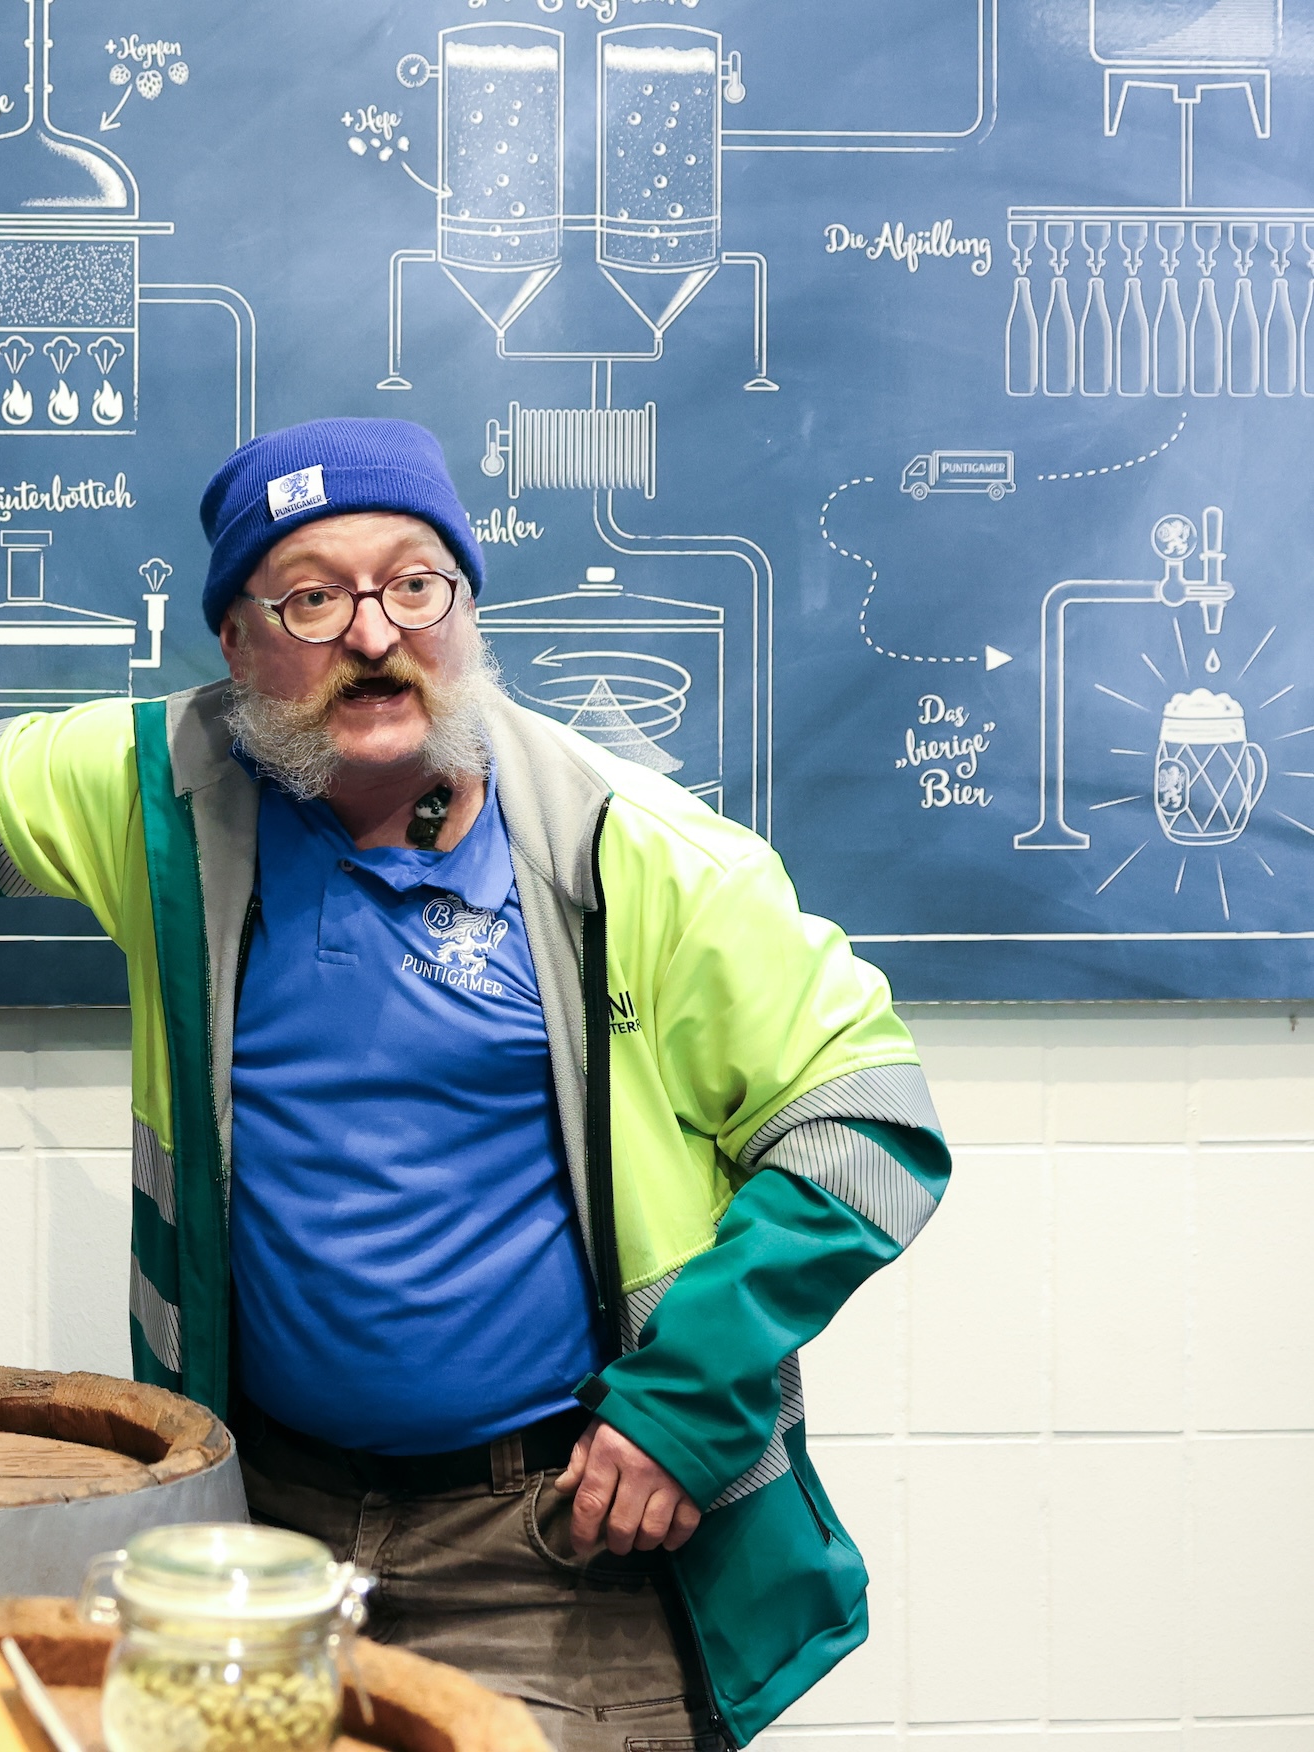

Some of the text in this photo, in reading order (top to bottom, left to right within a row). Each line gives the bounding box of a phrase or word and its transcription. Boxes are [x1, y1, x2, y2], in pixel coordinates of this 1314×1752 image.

[824, 218, 992, 277] Die Abfüllung
[942, 462, 1005, 473] PUNTIGAMER
[274, 494, 323, 517] PUNTIGAMER
[918, 694, 970, 727] Das
[919, 768, 994, 808] Bier
[401, 954, 503, 996] PUNTIGAMER
